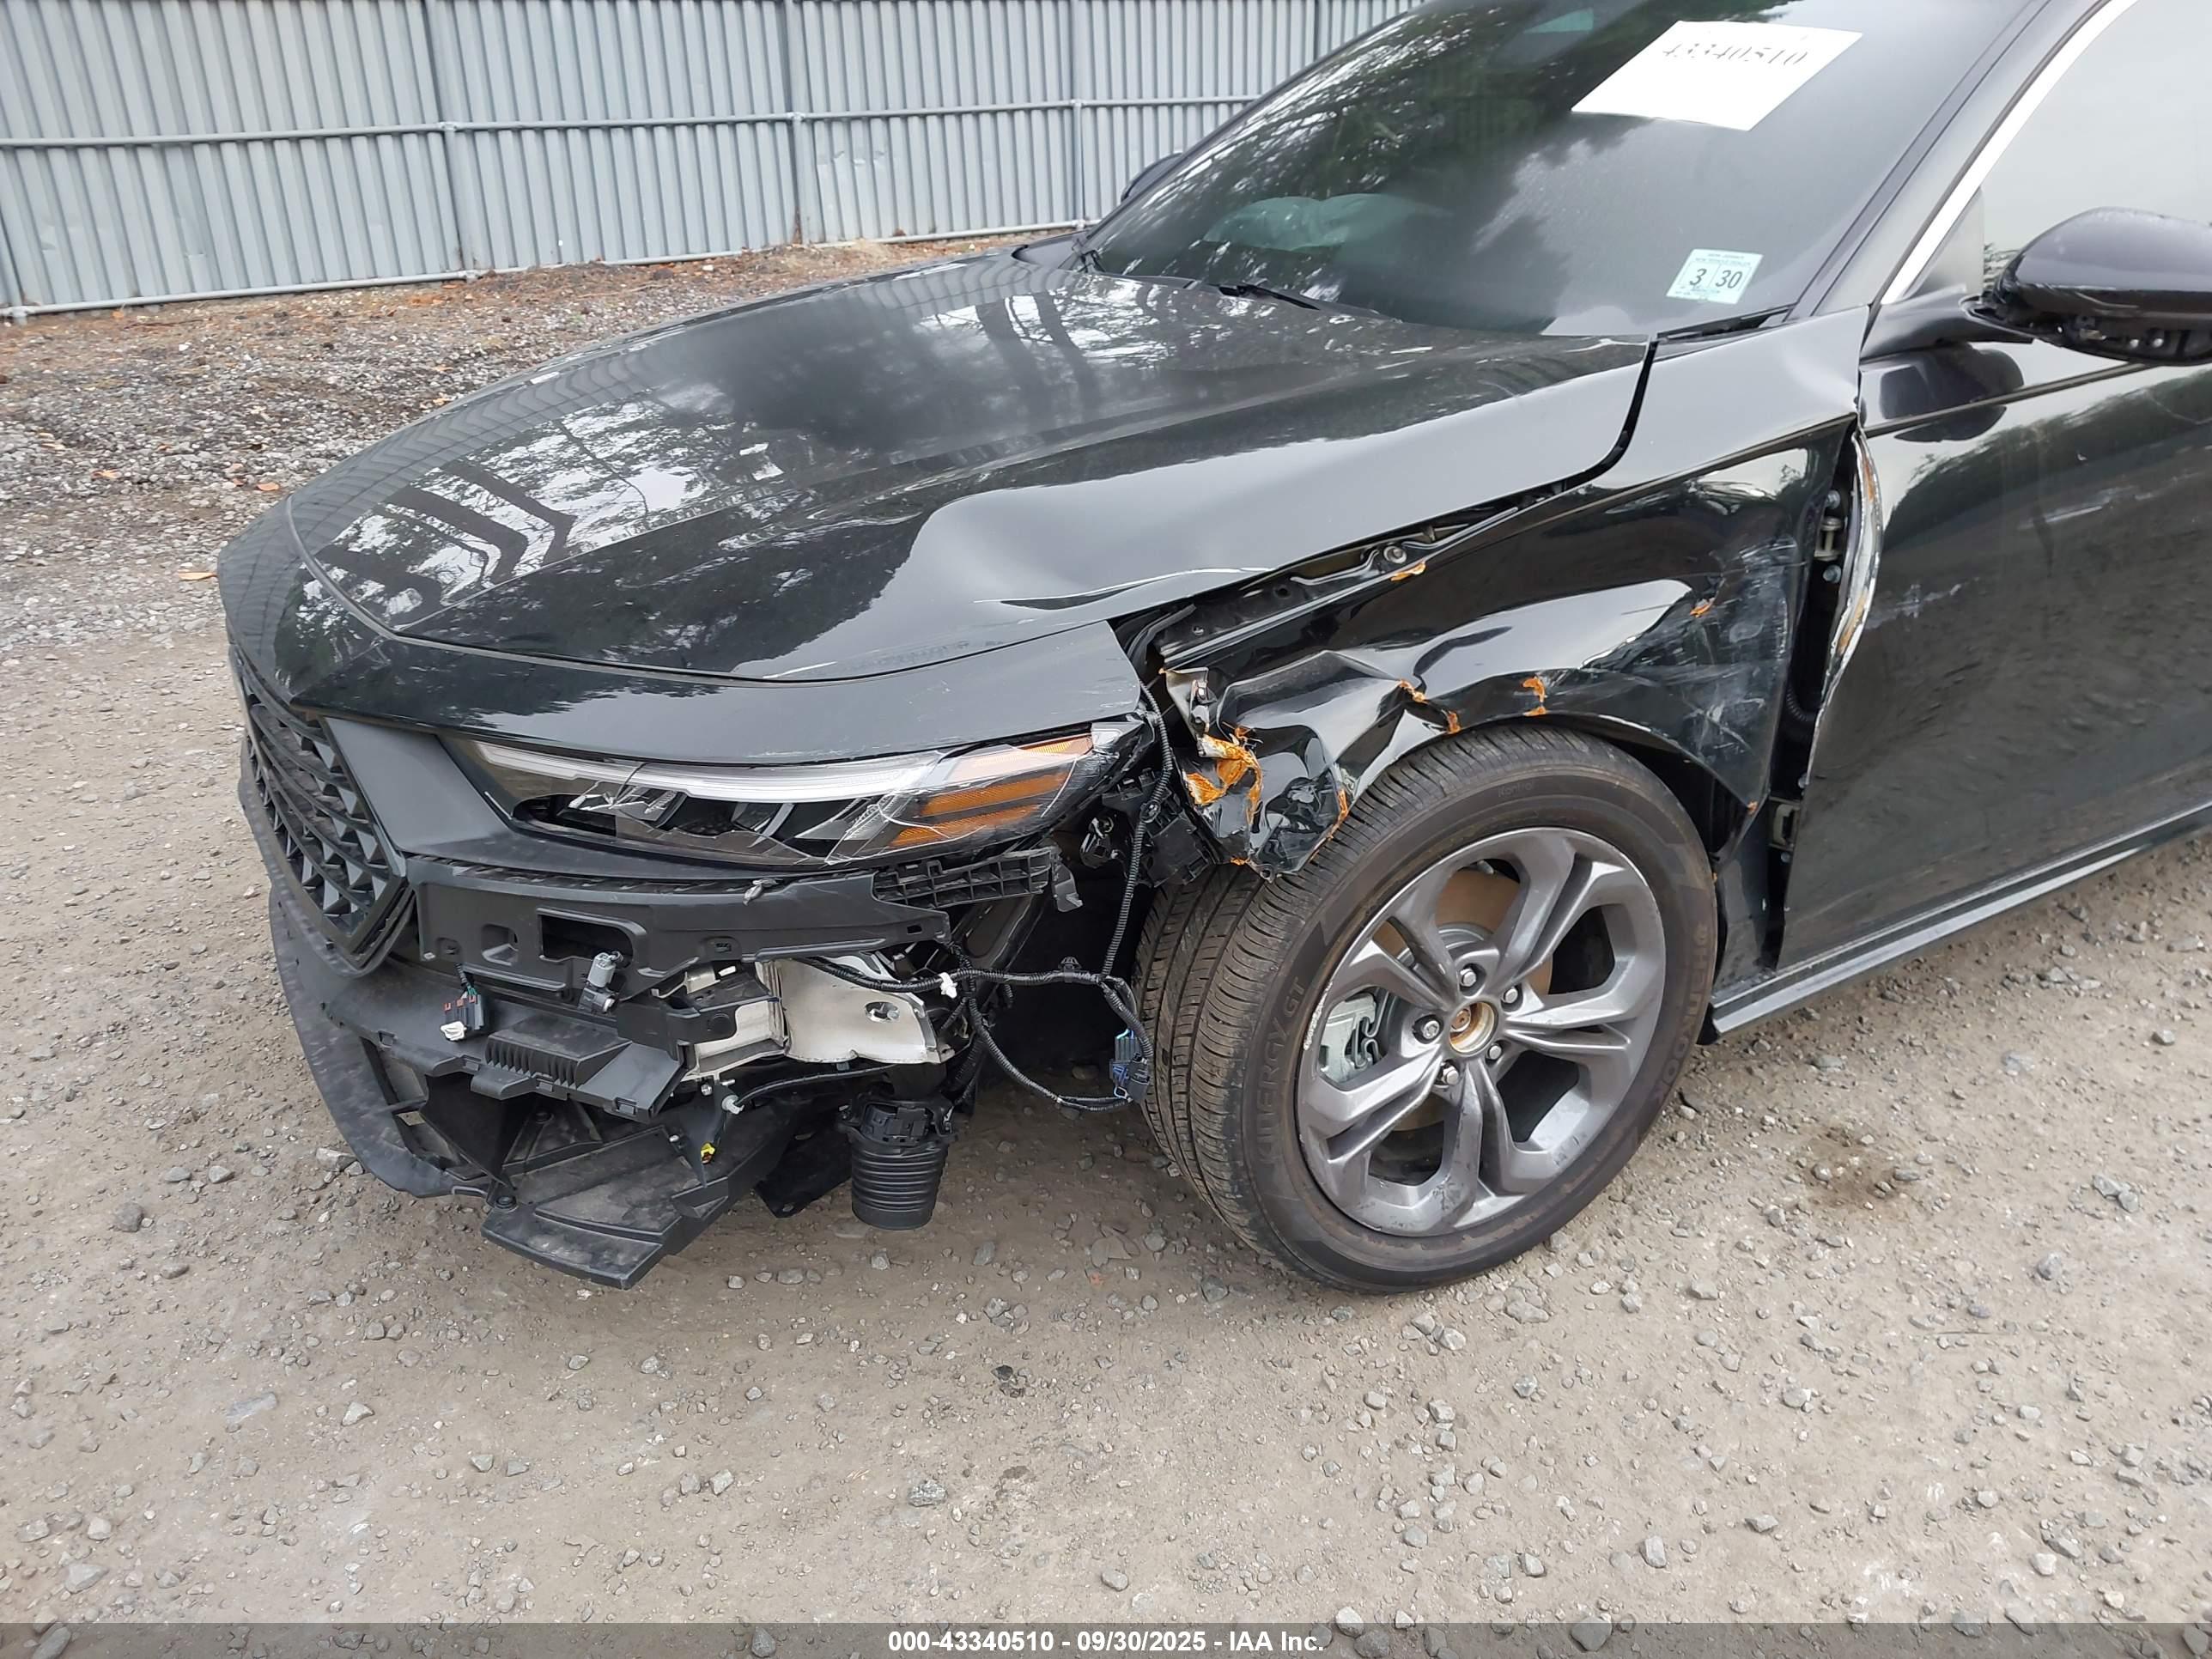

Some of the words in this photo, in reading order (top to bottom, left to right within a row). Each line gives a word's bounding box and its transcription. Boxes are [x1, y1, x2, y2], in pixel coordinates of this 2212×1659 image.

[1689, 268, 1707, 286] 3
[1715, 270, 1743, 289] 30
[1285, 975, 1306, 1017] GT
